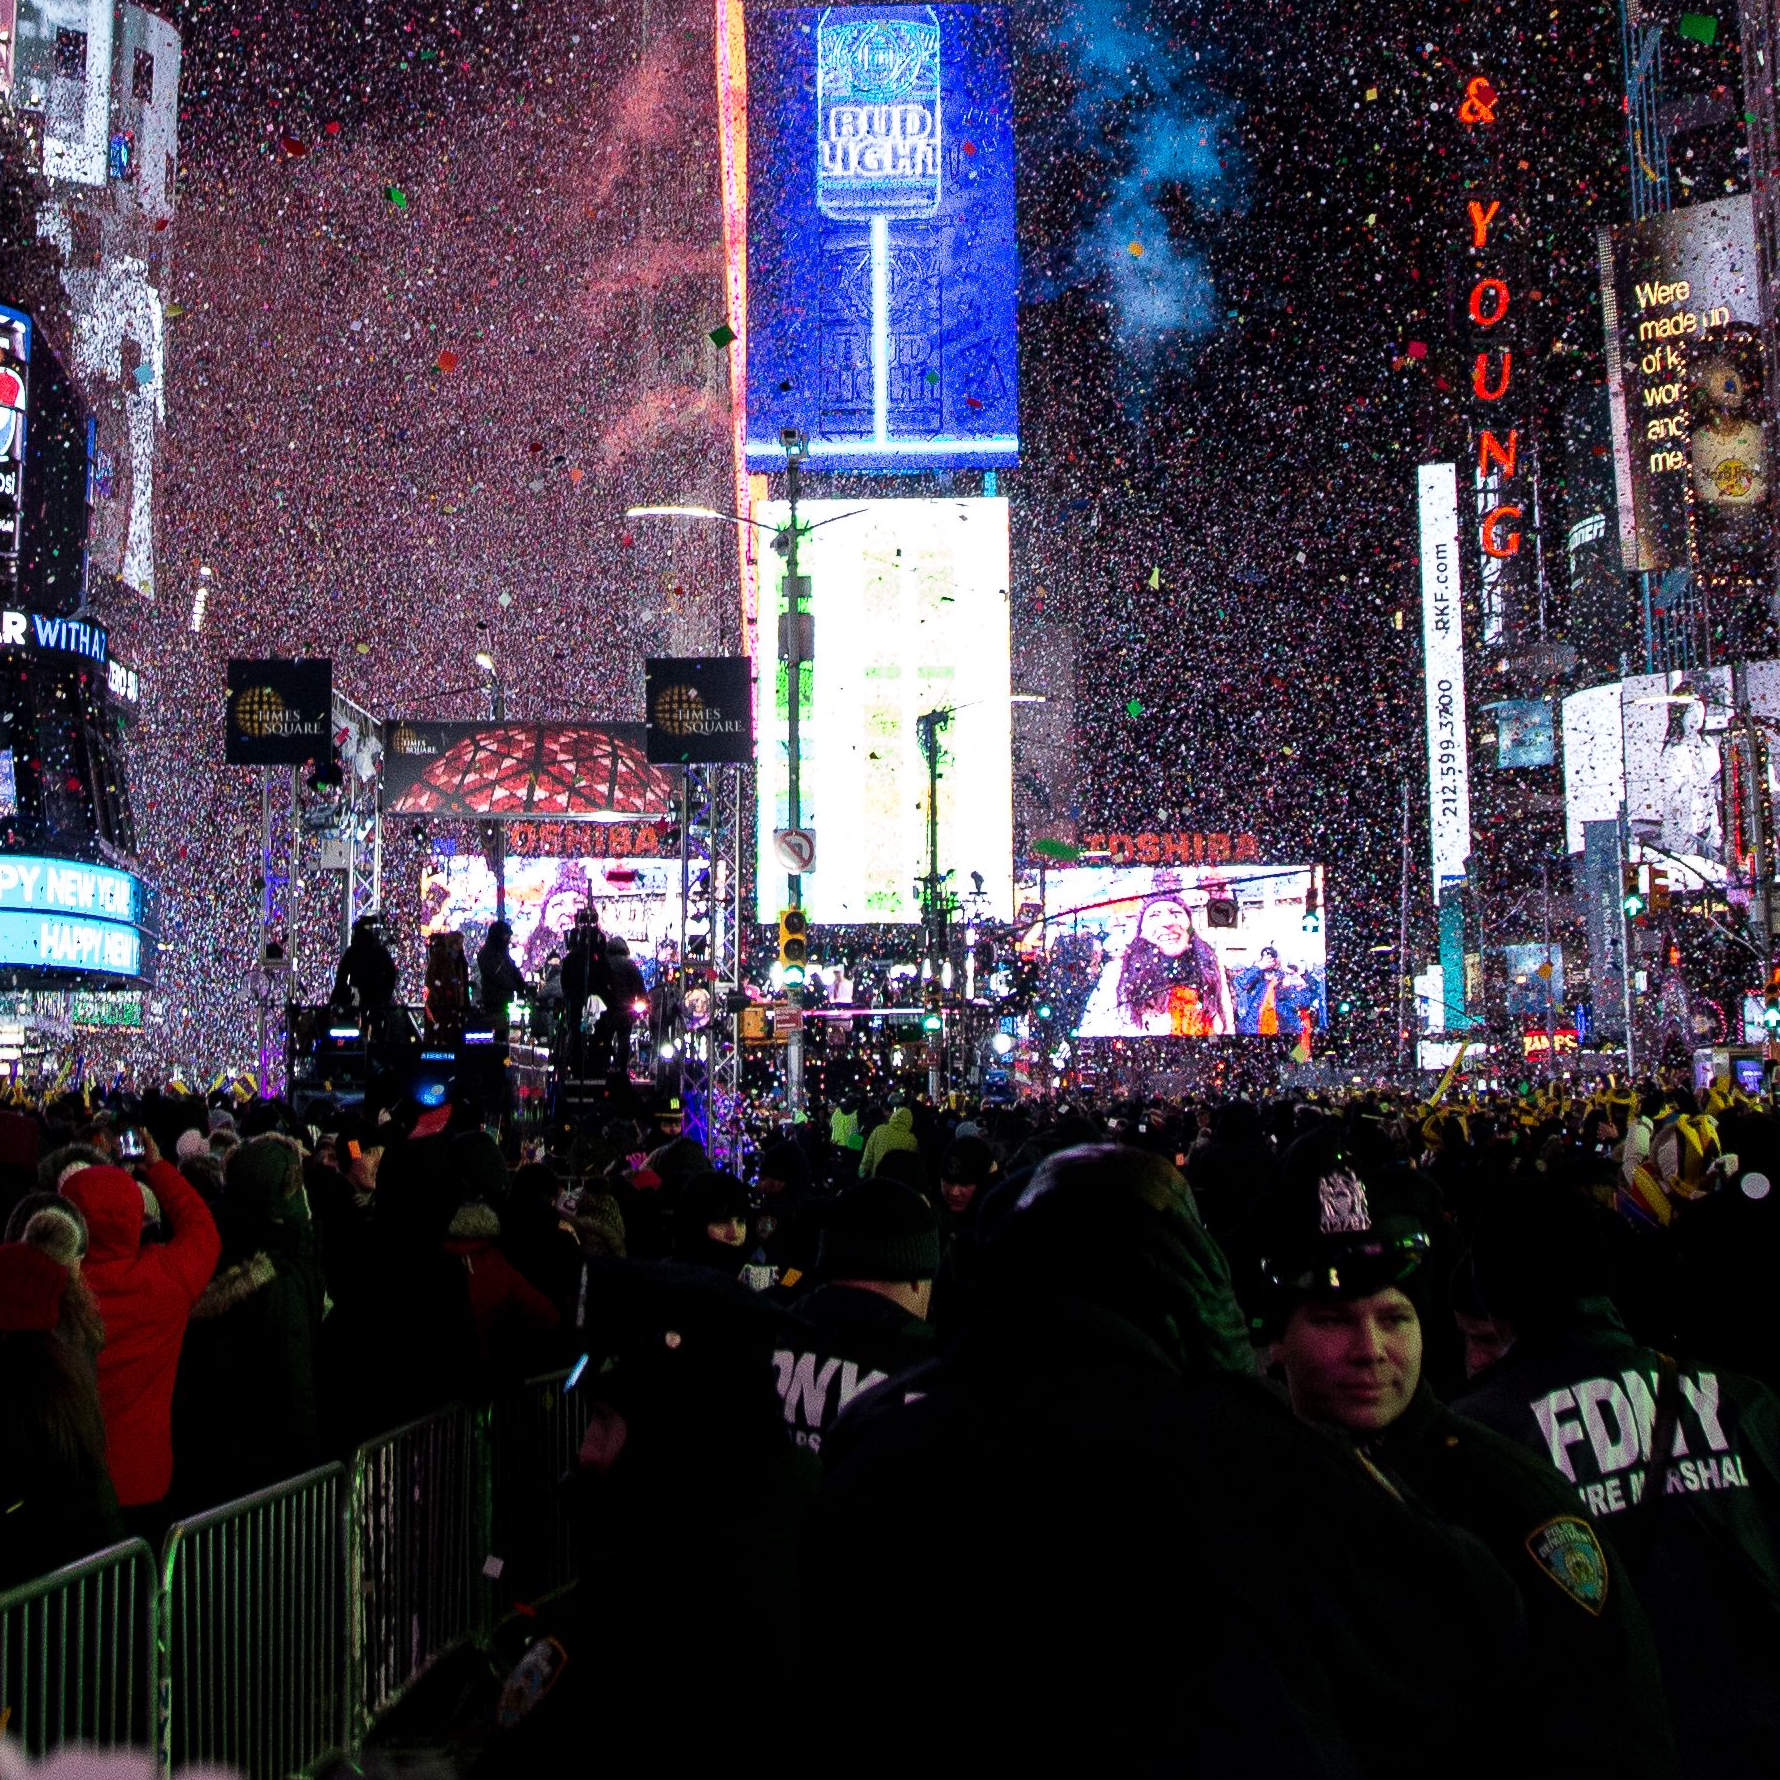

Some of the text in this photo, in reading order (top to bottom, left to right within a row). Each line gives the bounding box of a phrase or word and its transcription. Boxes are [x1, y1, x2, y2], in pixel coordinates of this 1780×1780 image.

[1461, 77, 1499, 123] &
[829, 104, 931, 142] BUD
[822, 137, 941, 180] LIGHT
[1640, 311, 1697, 341] made
[1468, 200, 1522, 558] YOUNG
[258, 709, 301, 722] TIMES
[264, 722, 322, 738] SQUARE
[677, 707, 722, 721] TIMES
[683, 719, 743, 736] SQUARE
[510, 823, 659, 856] OSHIBA
[1083, 832, 1260, 863] TOSHIBA
[47, 867, 95, 907] NEW
[1628, 1454, 1750, 1507] MRSHAL
